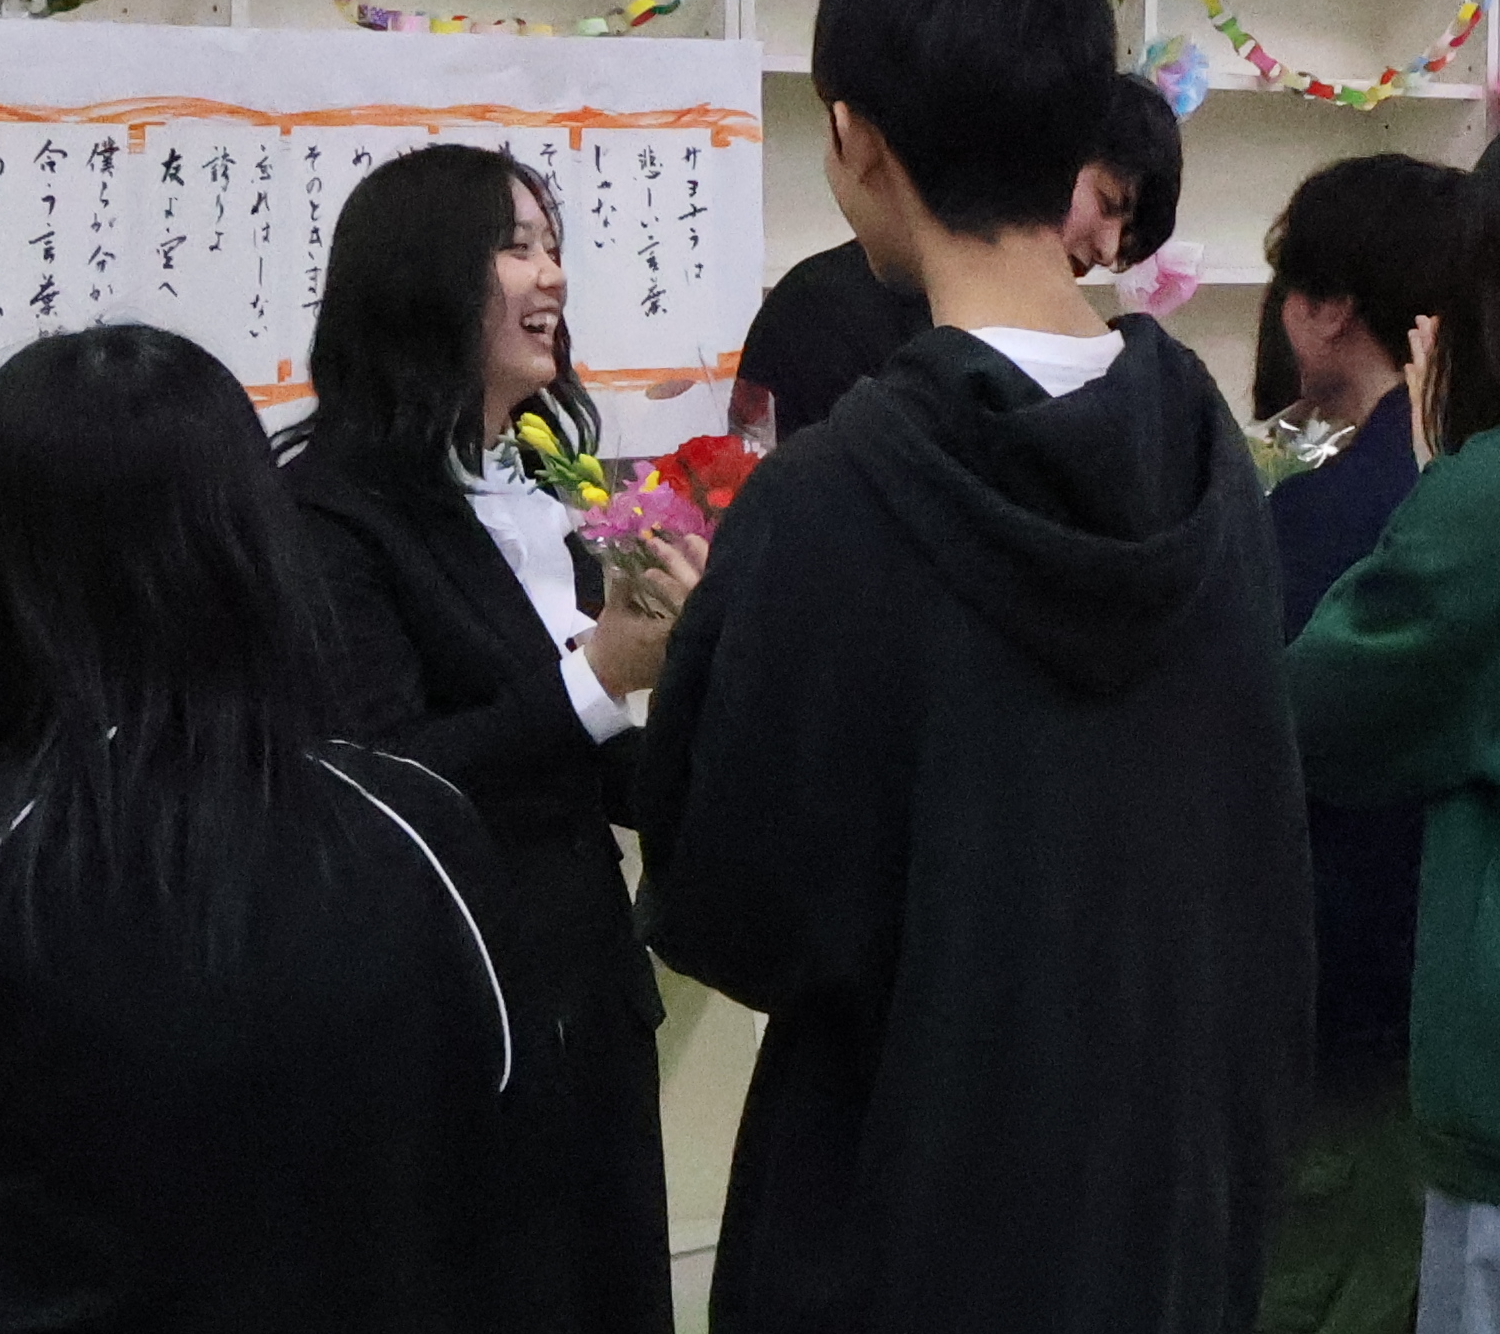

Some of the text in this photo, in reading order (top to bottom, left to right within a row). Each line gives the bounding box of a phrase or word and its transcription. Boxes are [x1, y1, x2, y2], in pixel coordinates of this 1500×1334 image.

[202, 145, 236, 252] 誇りよ
[249, 143, 273, 339] 忘れはしない
[633, 145, 668, 318] 悲しい言葉
[678, 146, 707, 282] サヨナラは
